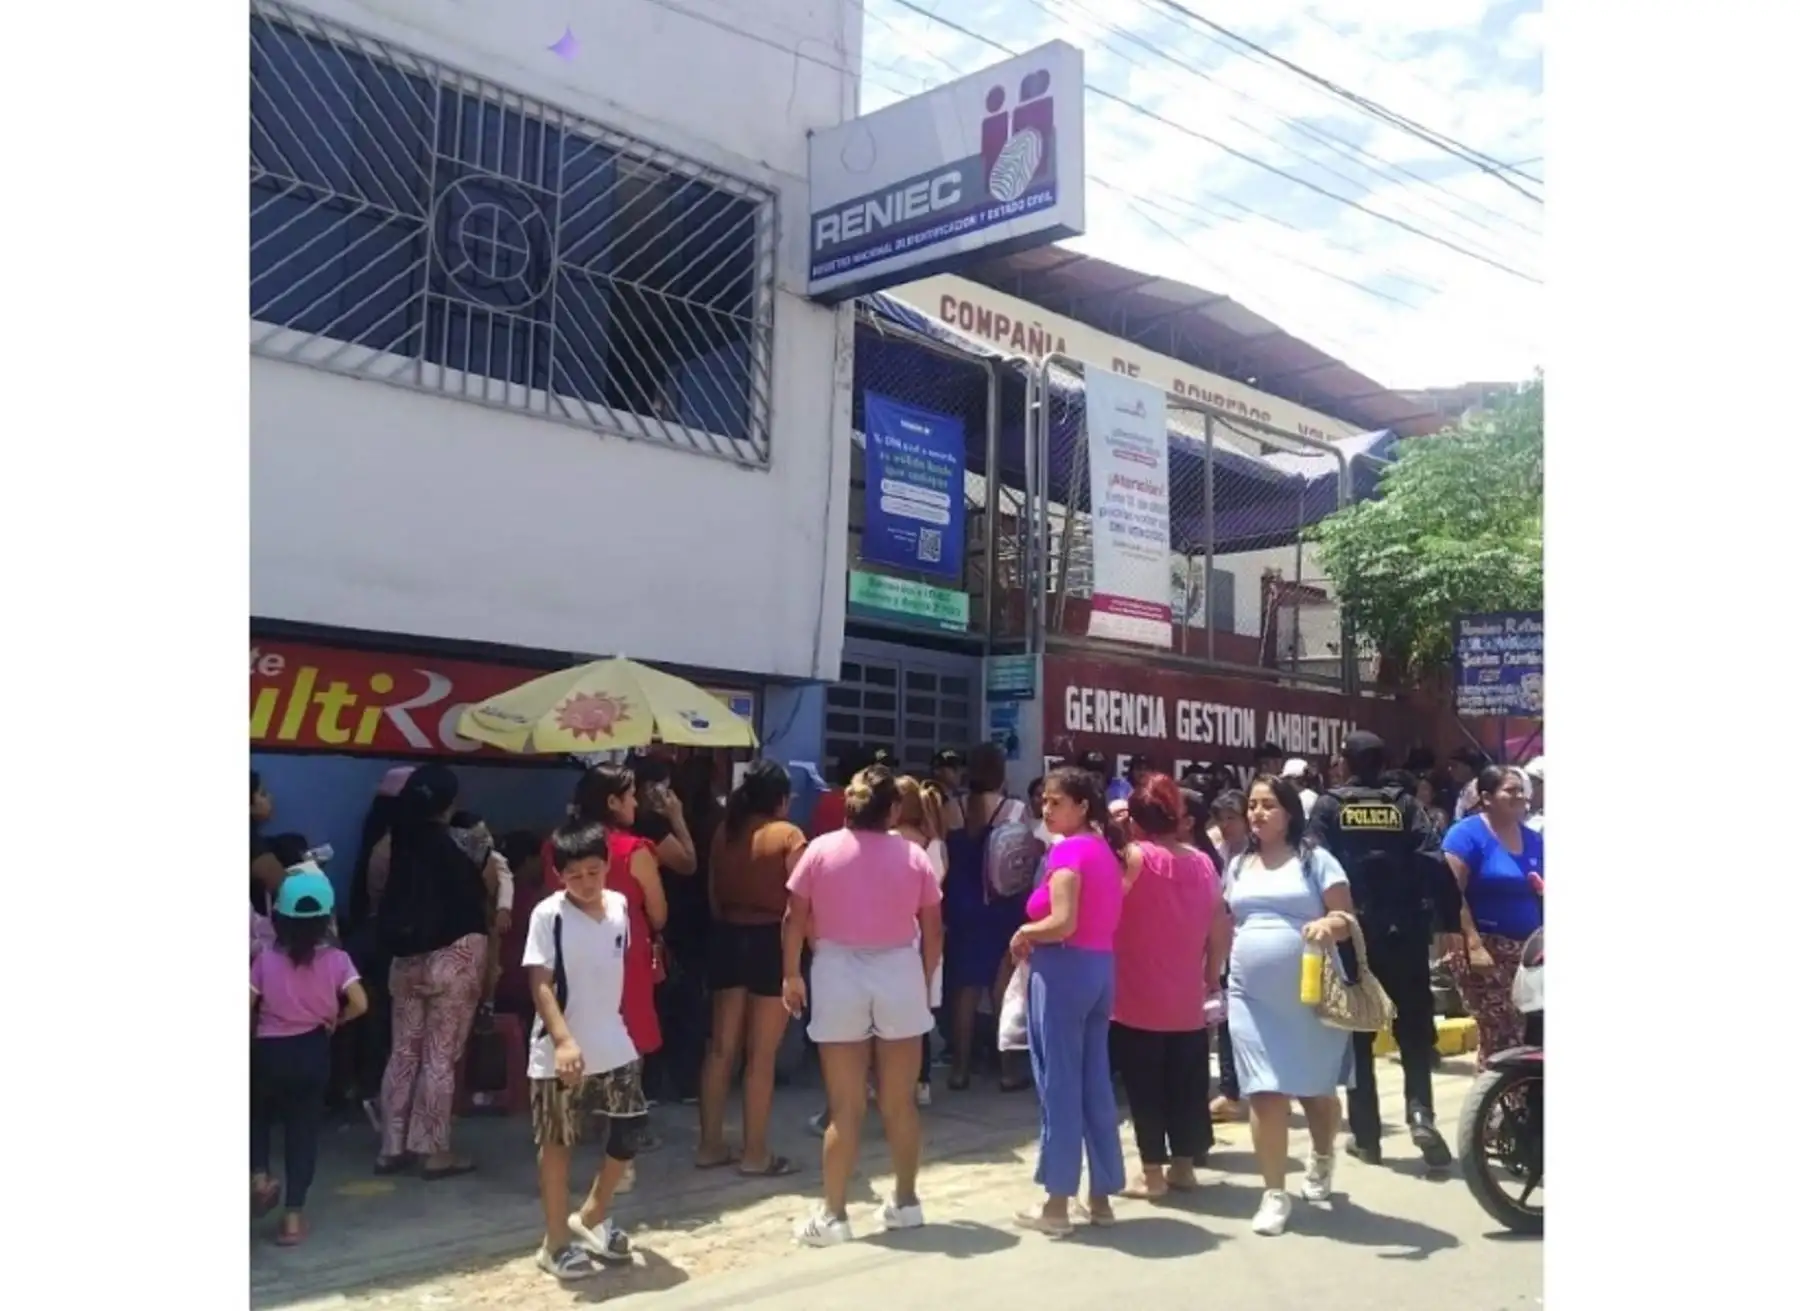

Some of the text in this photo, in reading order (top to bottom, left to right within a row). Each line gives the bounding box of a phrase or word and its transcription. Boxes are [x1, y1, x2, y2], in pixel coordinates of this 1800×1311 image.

[815, 170, 962, 250] RENIEC
[853, 242, 893, 263] NACIONAL
[940, 294, 1068, 356] COMPAÑIA
[1065, 685, 1166, 739] GERENCIA
[1176, 699, 1256, 749] GESTION
[1345, 809, 1399, 826] POLICIA
